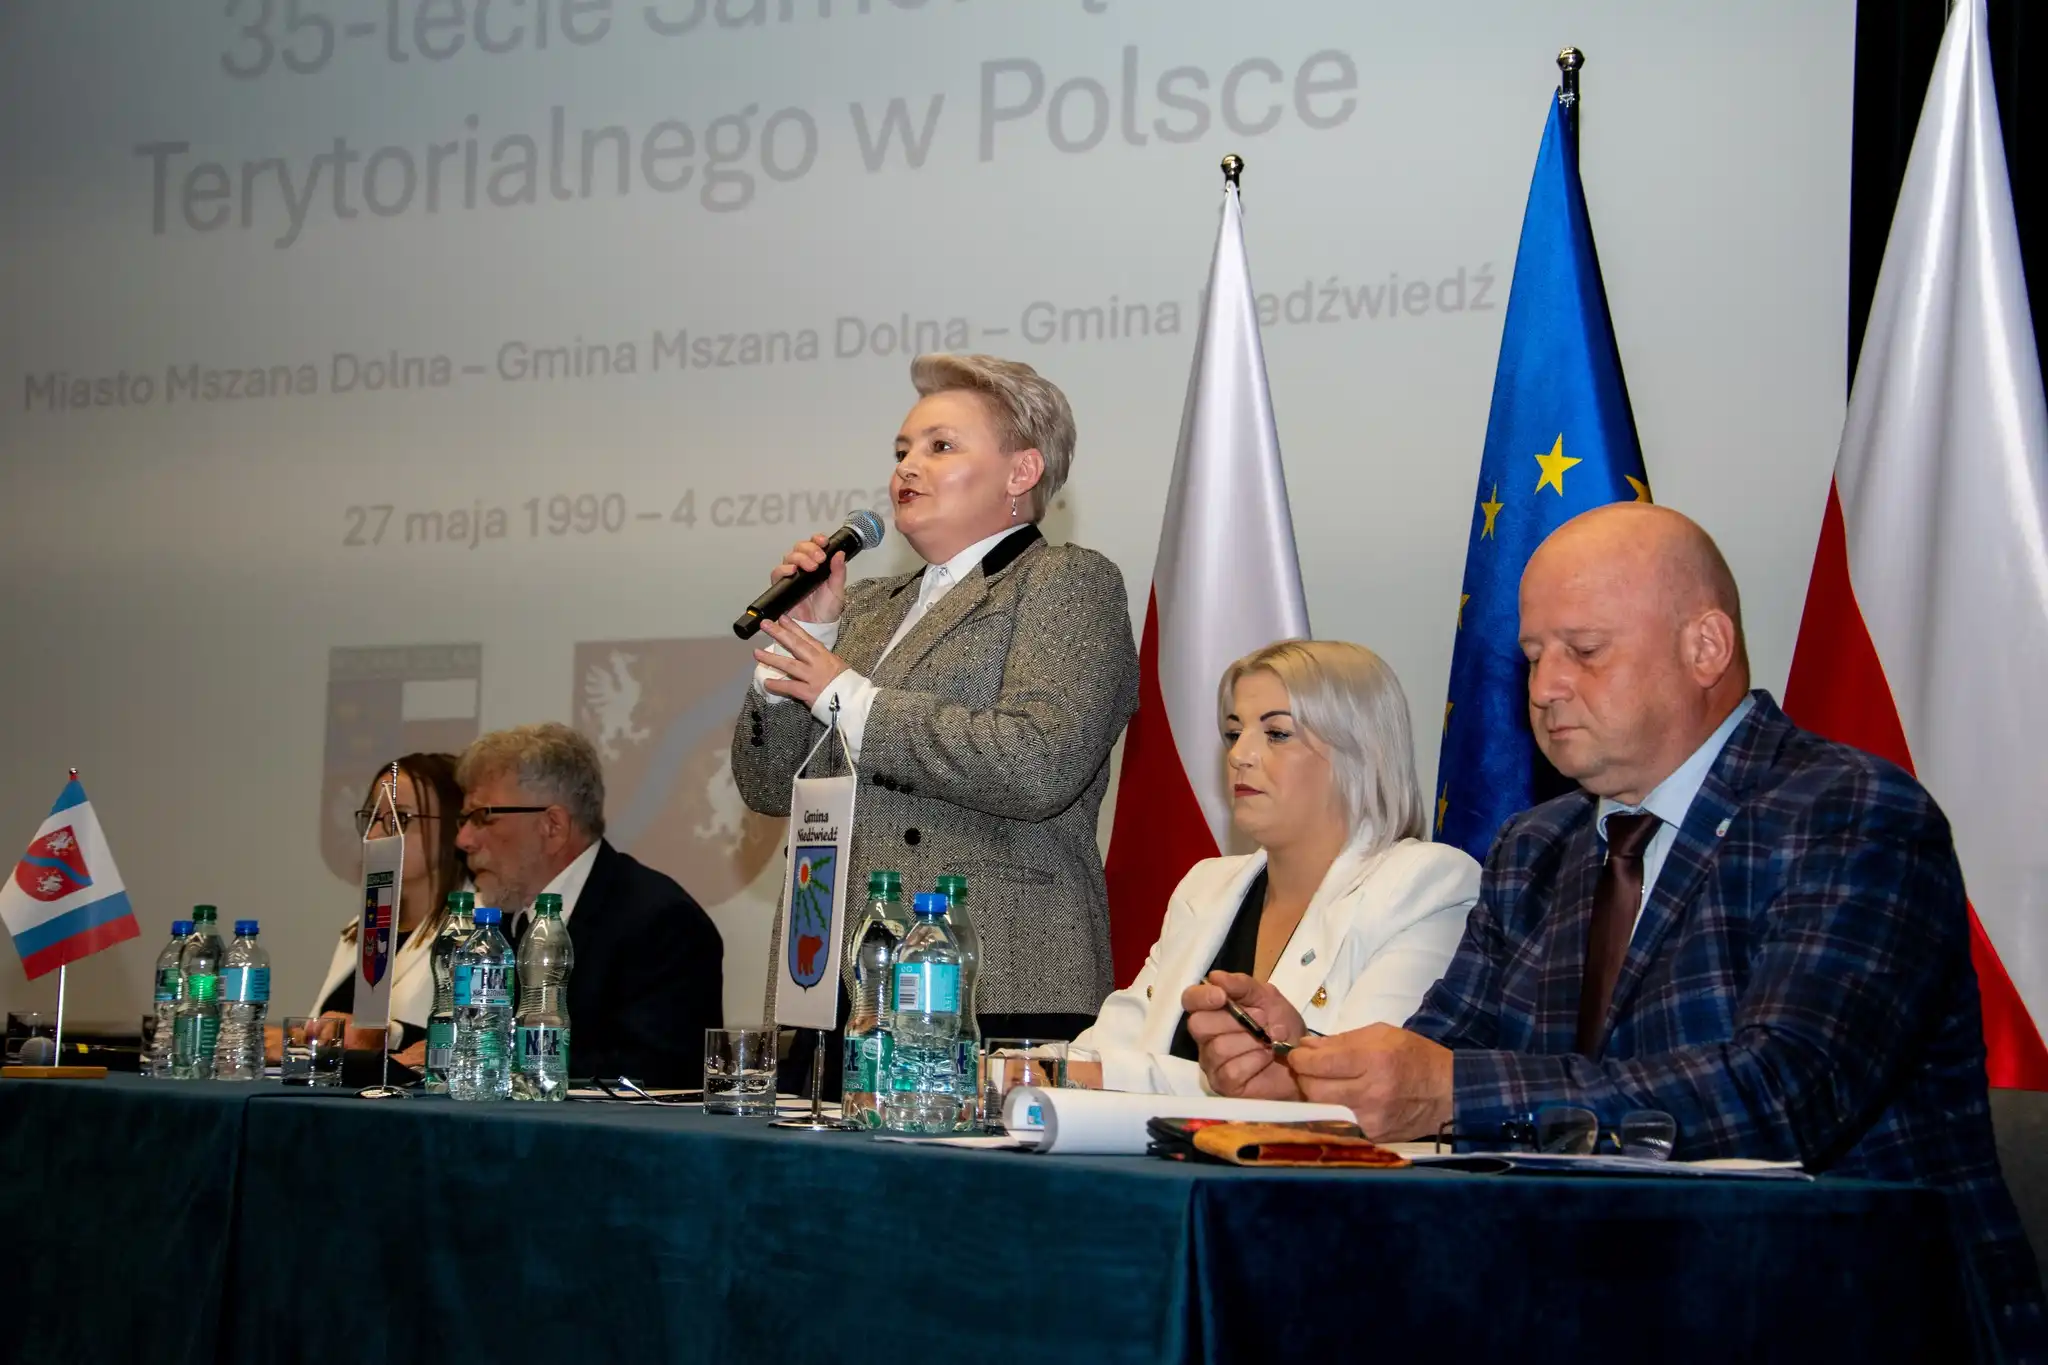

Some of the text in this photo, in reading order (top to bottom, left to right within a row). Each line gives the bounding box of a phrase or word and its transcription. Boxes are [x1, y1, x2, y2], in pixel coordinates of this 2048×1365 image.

[219, 0, 613, 80] 35-lecie
[132, 44, 1358, 249] Terytorialnego w Polsce
[24, 370, 153, 412] Miasto
[166, 363, 318, 404] Mszana
[331, 350, 452, 393] Dolna
[497, 335, 638, 381] Gmina
[652, 326, 820, 371] Mszana
[835, 313, 968, 359] Dolna
[1021, 295, 1181, 345] Gmina
[343, 504, 394, 547] 27
[405, 500, 507, 550] maja
[524, 492, 625, 538] 1990
[670, 488, 698, 529] 4
[804, 808, 829, 824] Gmina
